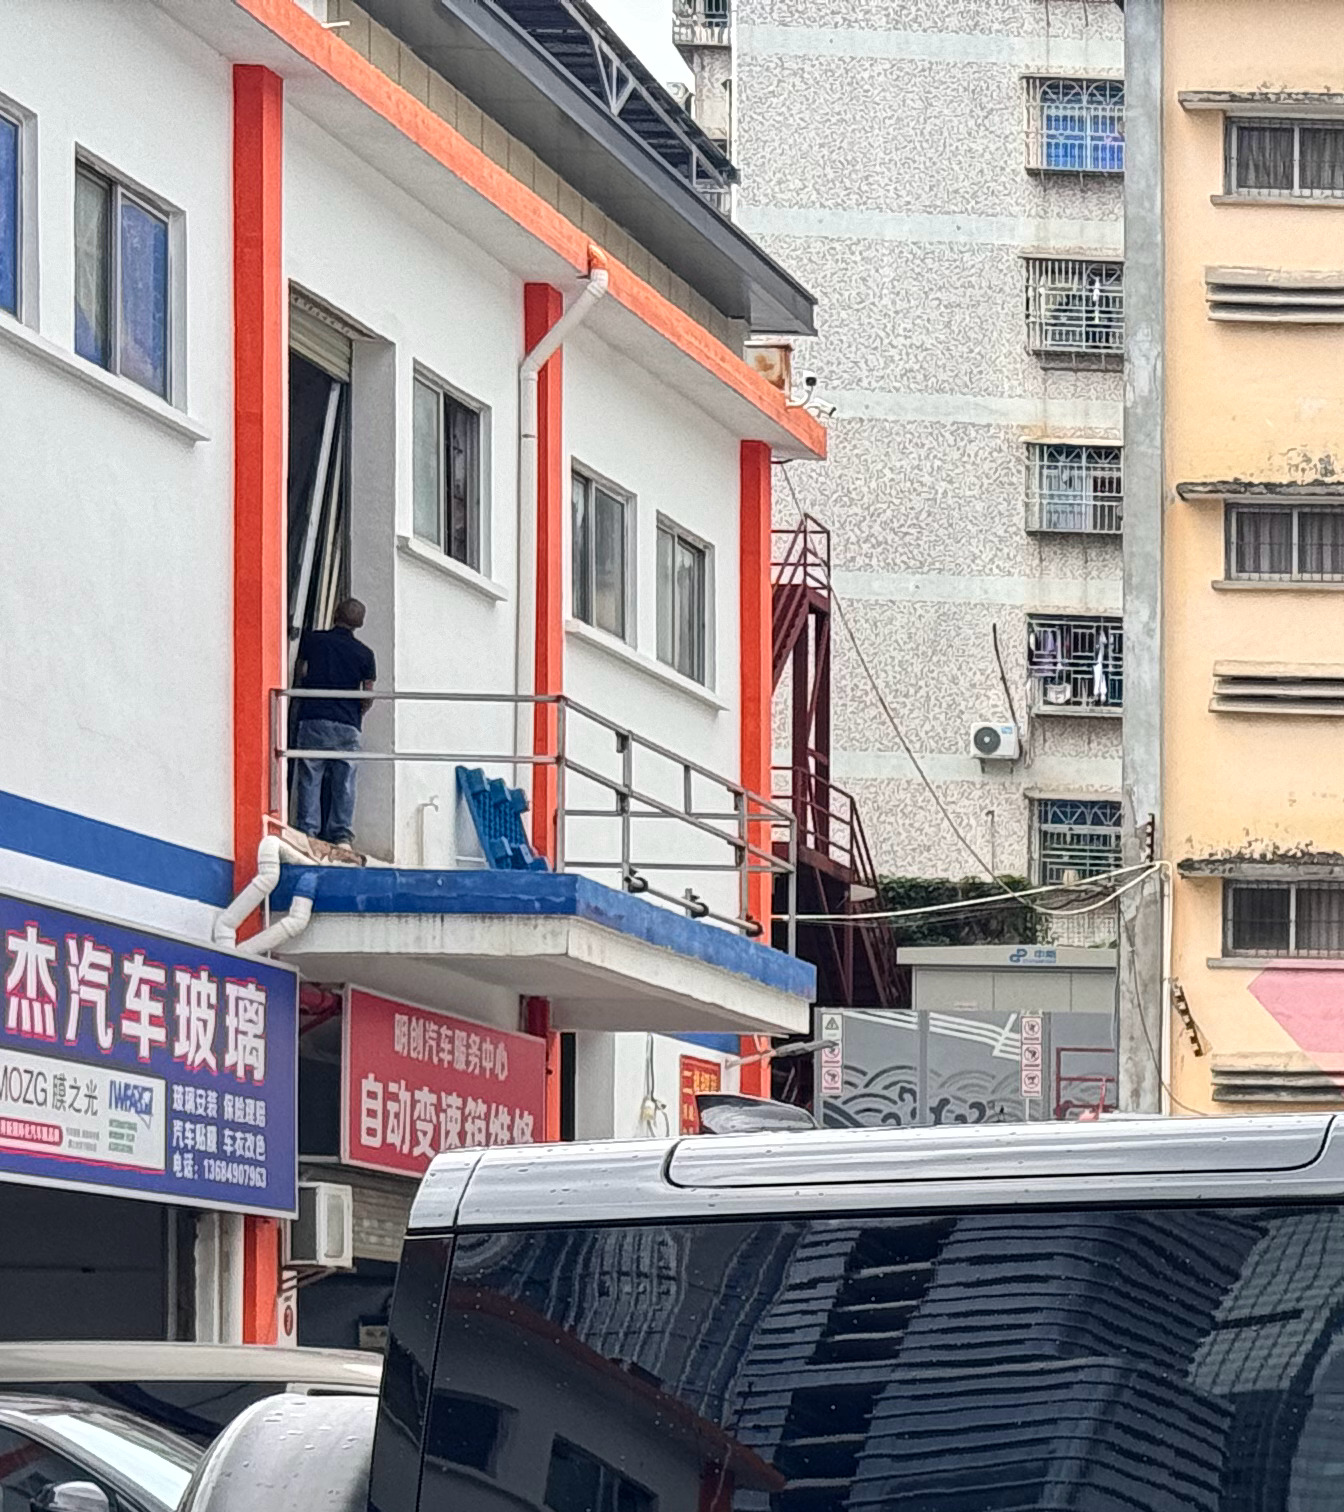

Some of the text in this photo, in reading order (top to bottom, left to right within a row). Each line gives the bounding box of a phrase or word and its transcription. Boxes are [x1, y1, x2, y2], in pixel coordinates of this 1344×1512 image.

[6, 922, 267, 1084] 杰汽车玻璃
[360, 1072, 535, 1158] 自动变速箱维修
